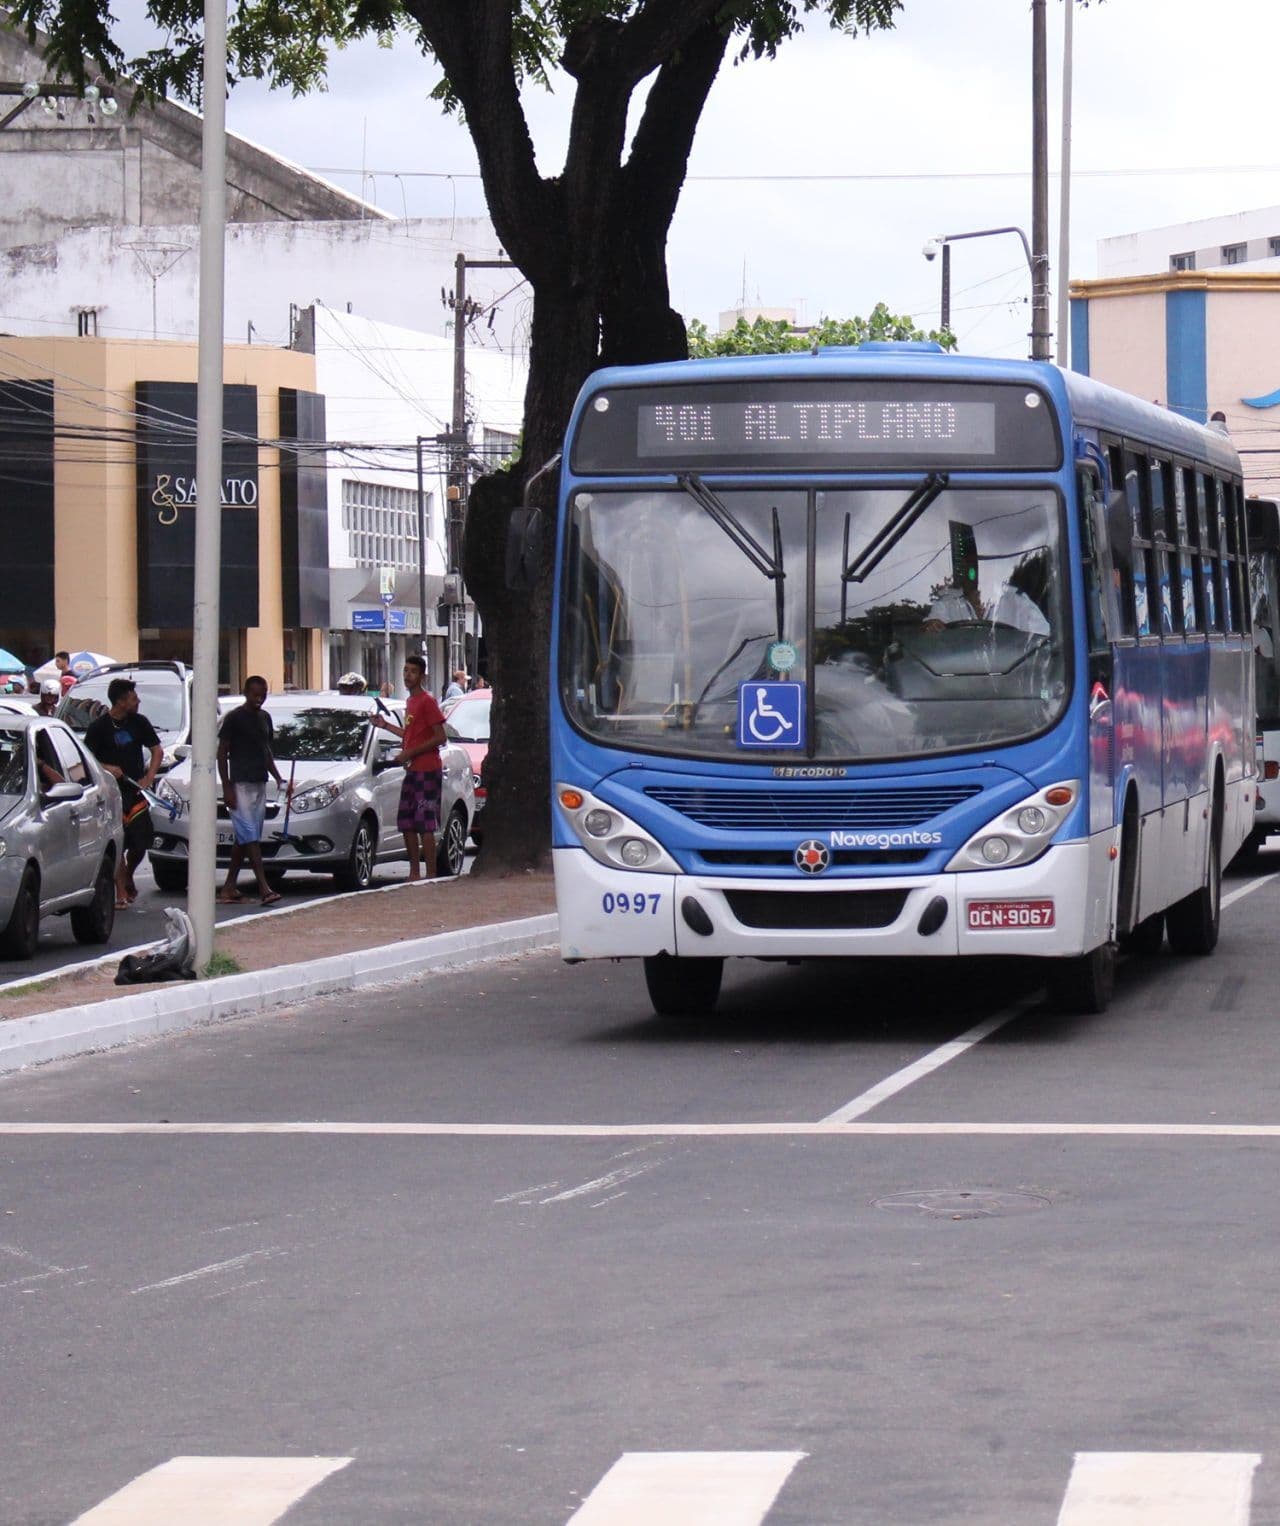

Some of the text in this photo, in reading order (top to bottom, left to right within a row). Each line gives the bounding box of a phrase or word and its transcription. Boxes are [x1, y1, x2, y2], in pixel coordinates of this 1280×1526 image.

[655, 402, 955, 440] 401 ALTIPLANO
[830, 831, 943, 850] Navegantes
[602, 892, 662, 915] 0997
